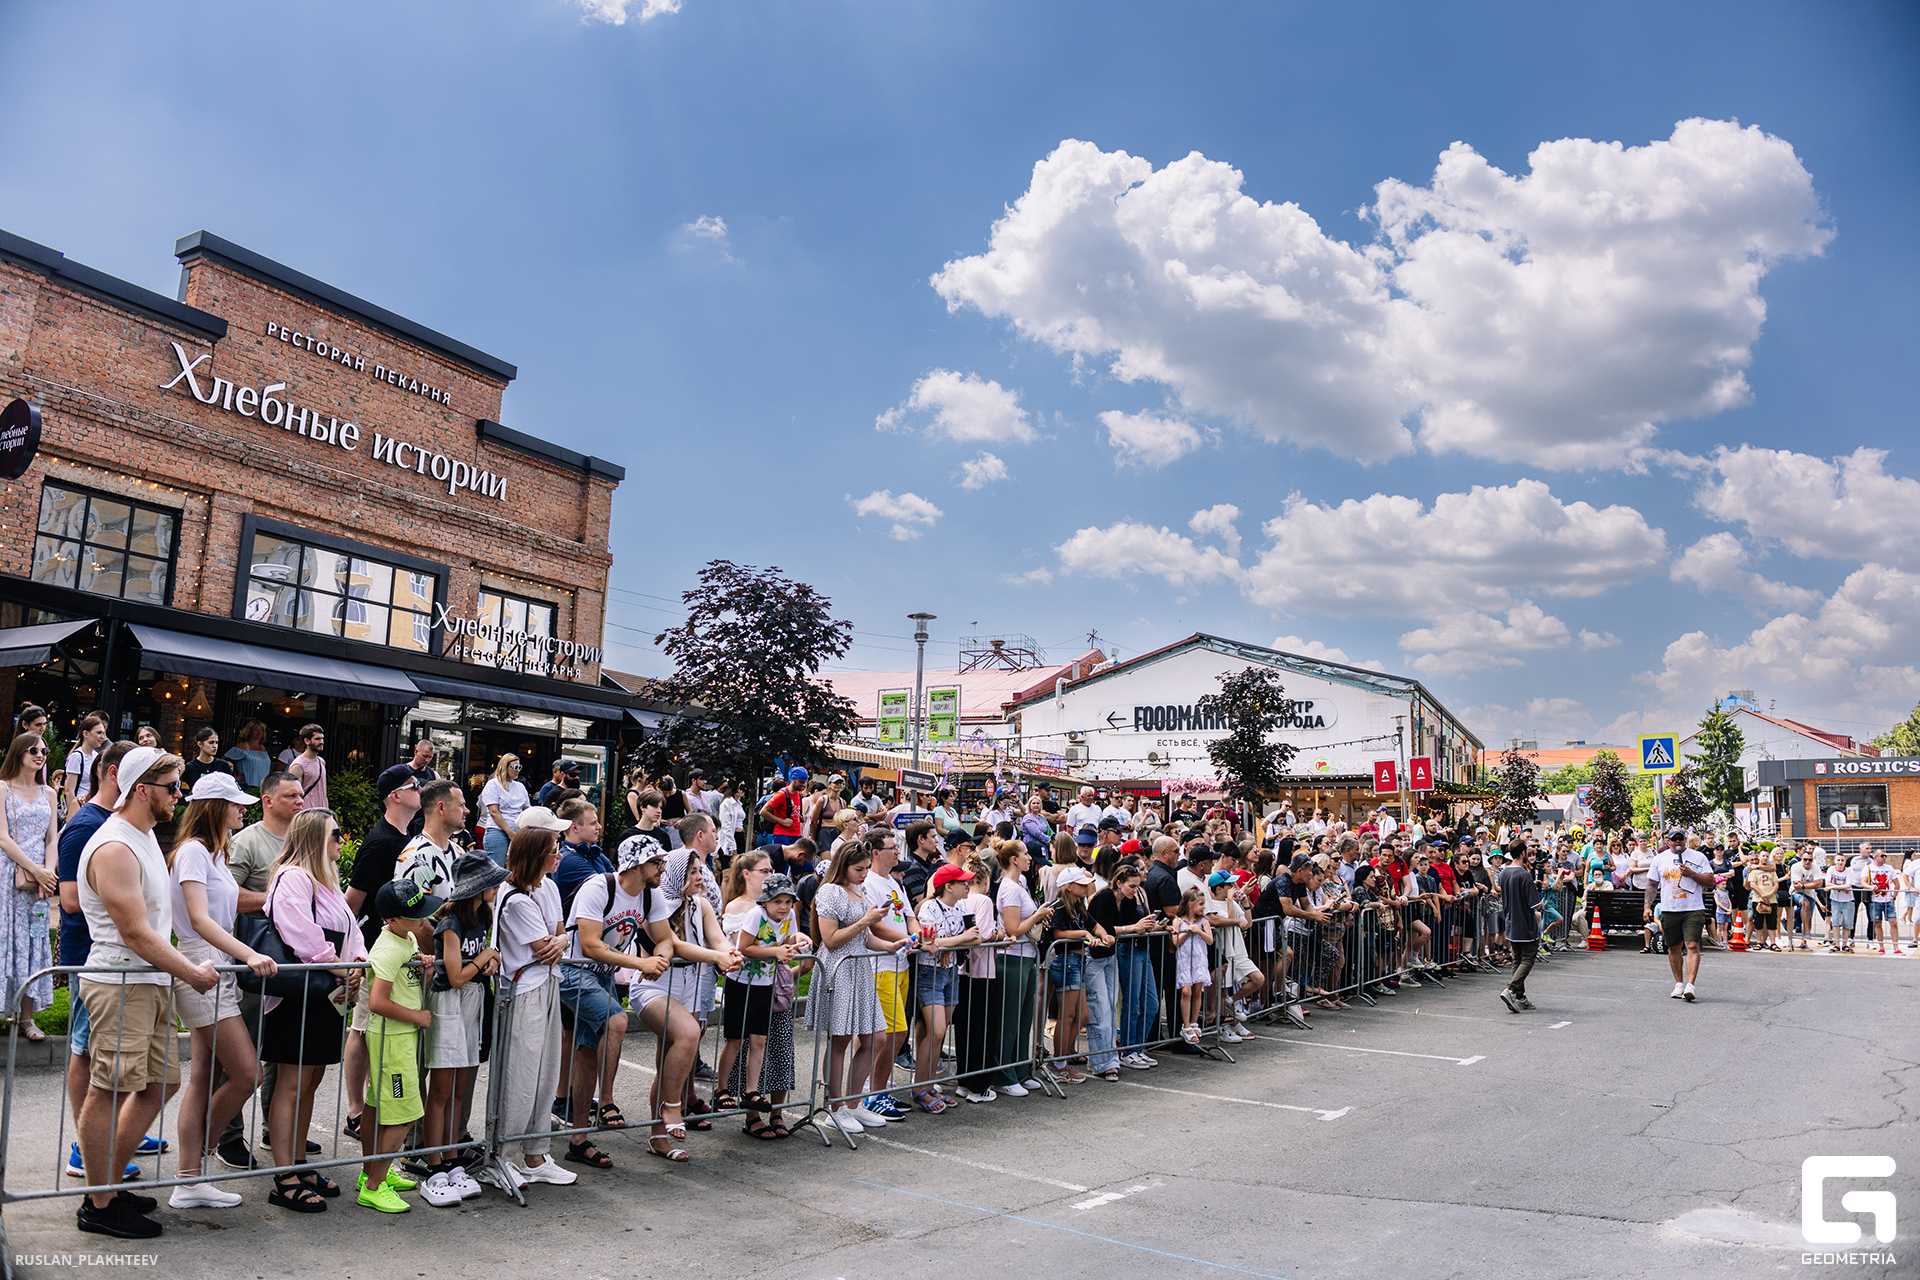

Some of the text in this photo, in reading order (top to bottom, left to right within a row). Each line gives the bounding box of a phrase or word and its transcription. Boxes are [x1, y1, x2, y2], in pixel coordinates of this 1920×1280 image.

[267, 321, 452, 406] РЕСТОРАН ПЕКАРНЯ
[0, 425, 28, 440] лебные
[159, 341, 508, 501] Хлебные истории
[431, 601, 605, 664] Хлебные истории
[454, 644, 581, 679] РЕСТОРАН ПЕКАРНЯ
[1269, 715, 1325, 729] ОРОДА
[1157, 739, 1180, 747] ЕСТЬ
[1833, 760, 1920, 774] ROSTIC'S
